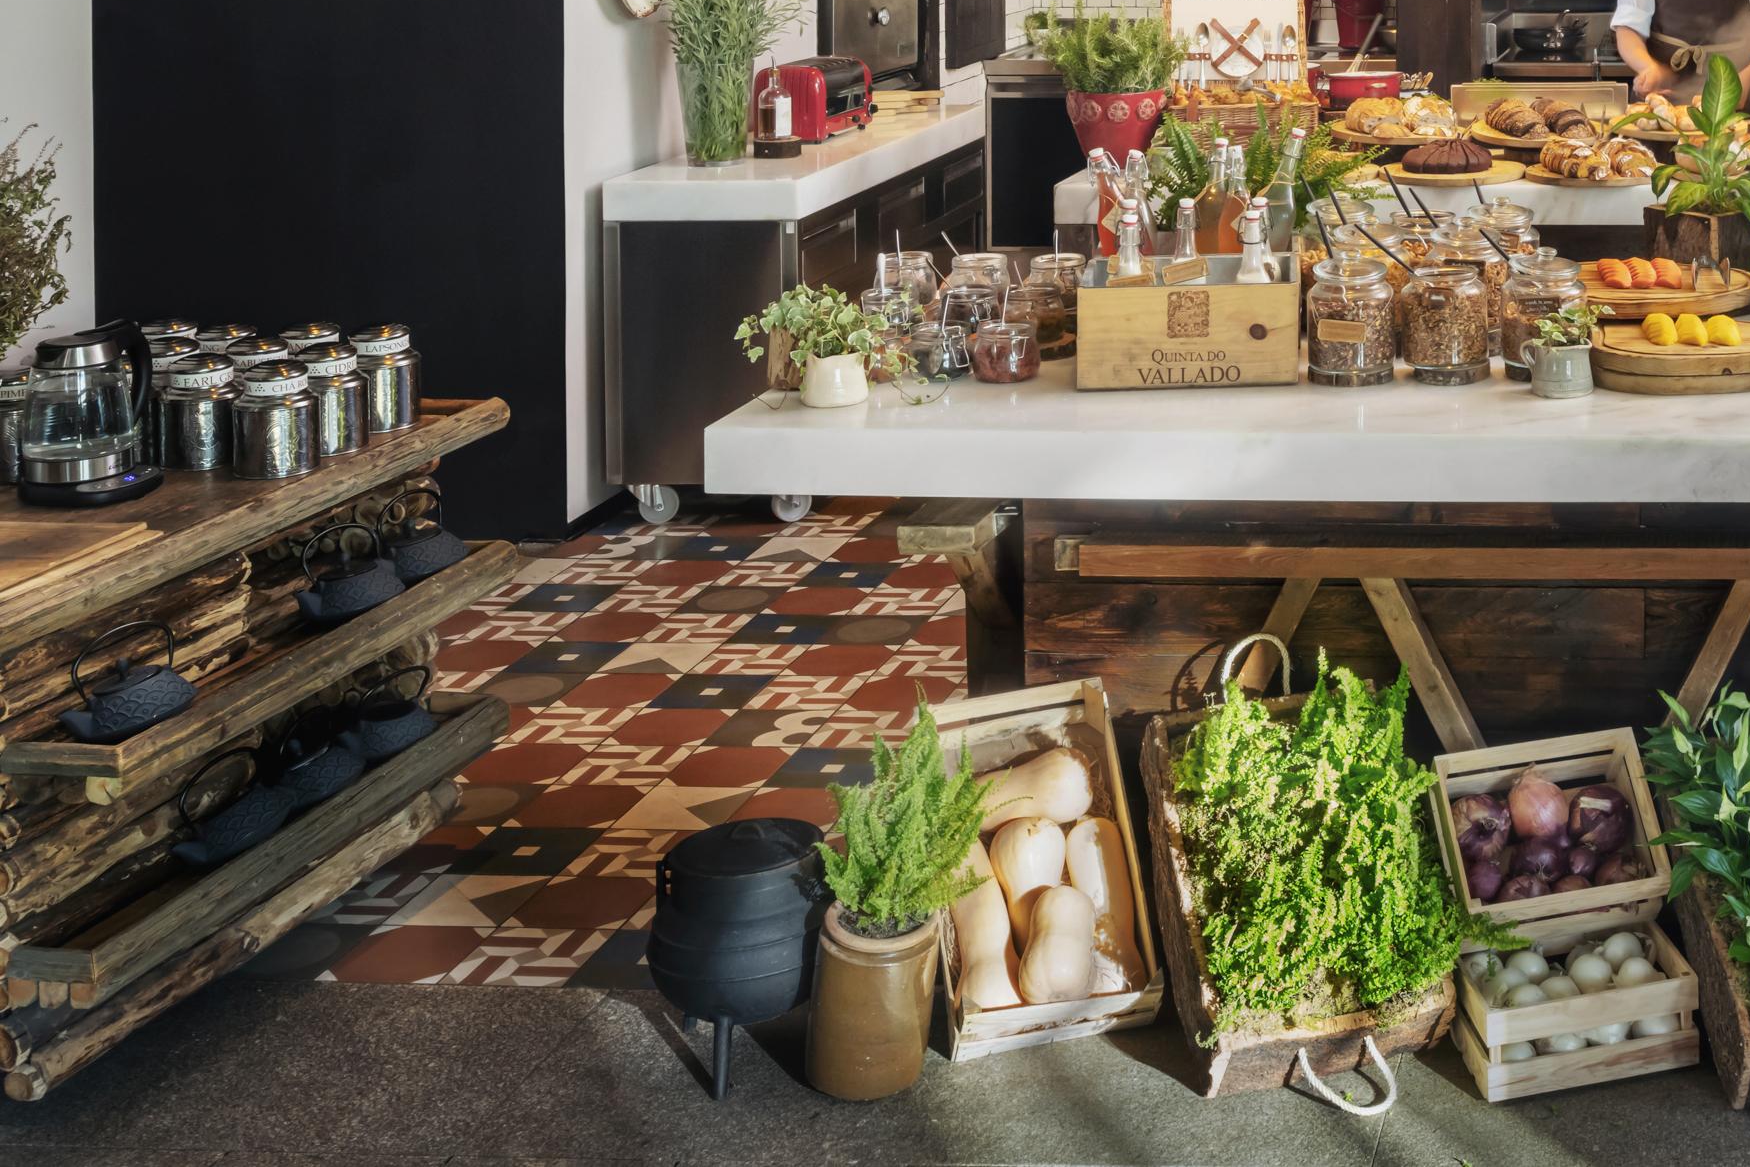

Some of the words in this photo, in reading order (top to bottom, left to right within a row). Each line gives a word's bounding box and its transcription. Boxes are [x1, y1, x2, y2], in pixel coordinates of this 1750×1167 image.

[1151, 349, 1203, 366] QUINTA
[1207, 350, 1226, 362] DO
[184, 376, 217, 388] EARL
[1137, 365, 1241, 384] VALLADO
